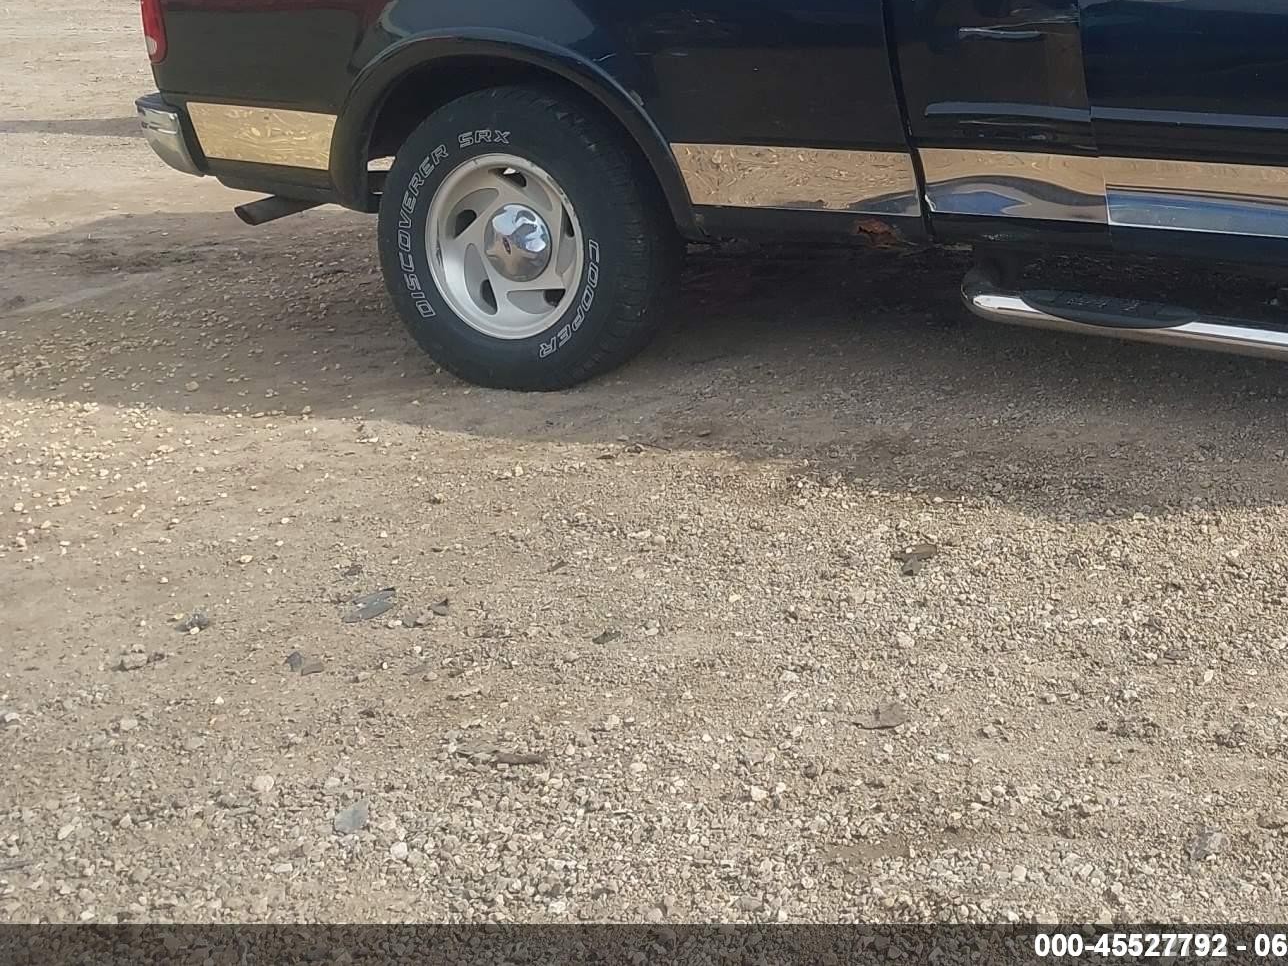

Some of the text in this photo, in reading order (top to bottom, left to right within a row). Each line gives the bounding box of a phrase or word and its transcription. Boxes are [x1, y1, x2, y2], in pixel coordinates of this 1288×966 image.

[397, 129, 511, 318] DISCOVERER SRX
[539, 239, 600, 358] COOPER
